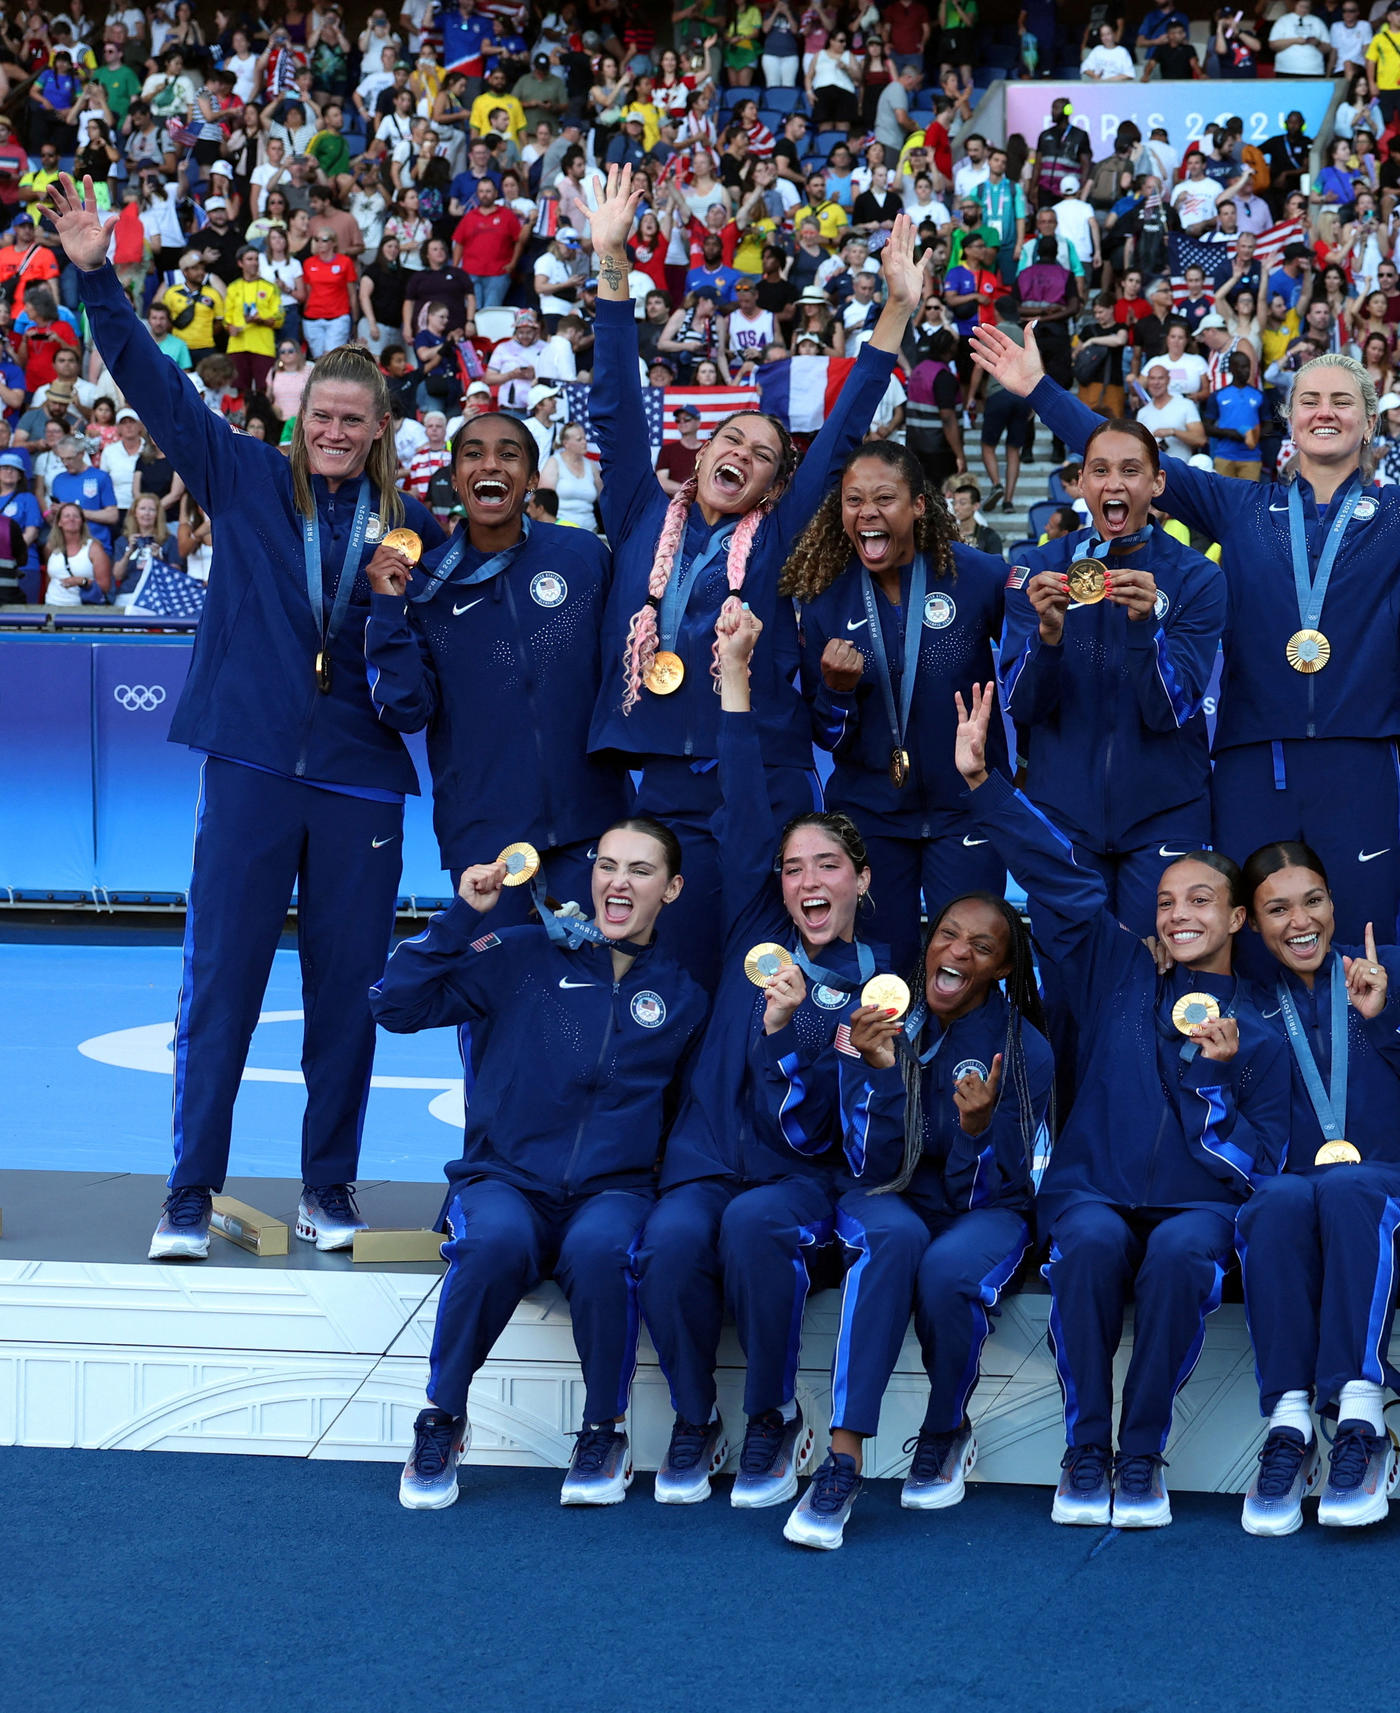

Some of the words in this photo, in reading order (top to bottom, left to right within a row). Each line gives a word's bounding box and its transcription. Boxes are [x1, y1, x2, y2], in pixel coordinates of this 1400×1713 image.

[736, 330, 766, 348] USA
[352, 526, 363, 548] PARIS
[359, 505, 367, 526] 2024
[1334, 512, 1346, 533] PARIS
[442, 551, 460, 570] 2024
[869, 614, 878, 638] PARIS
[574, 922, 598, 938] PARIS
[1281, 995, 1291, 1015] 2024
[905, 1016, 919, 1034] ARIS
[1287, 1015, 1299, 1036] PARIS
